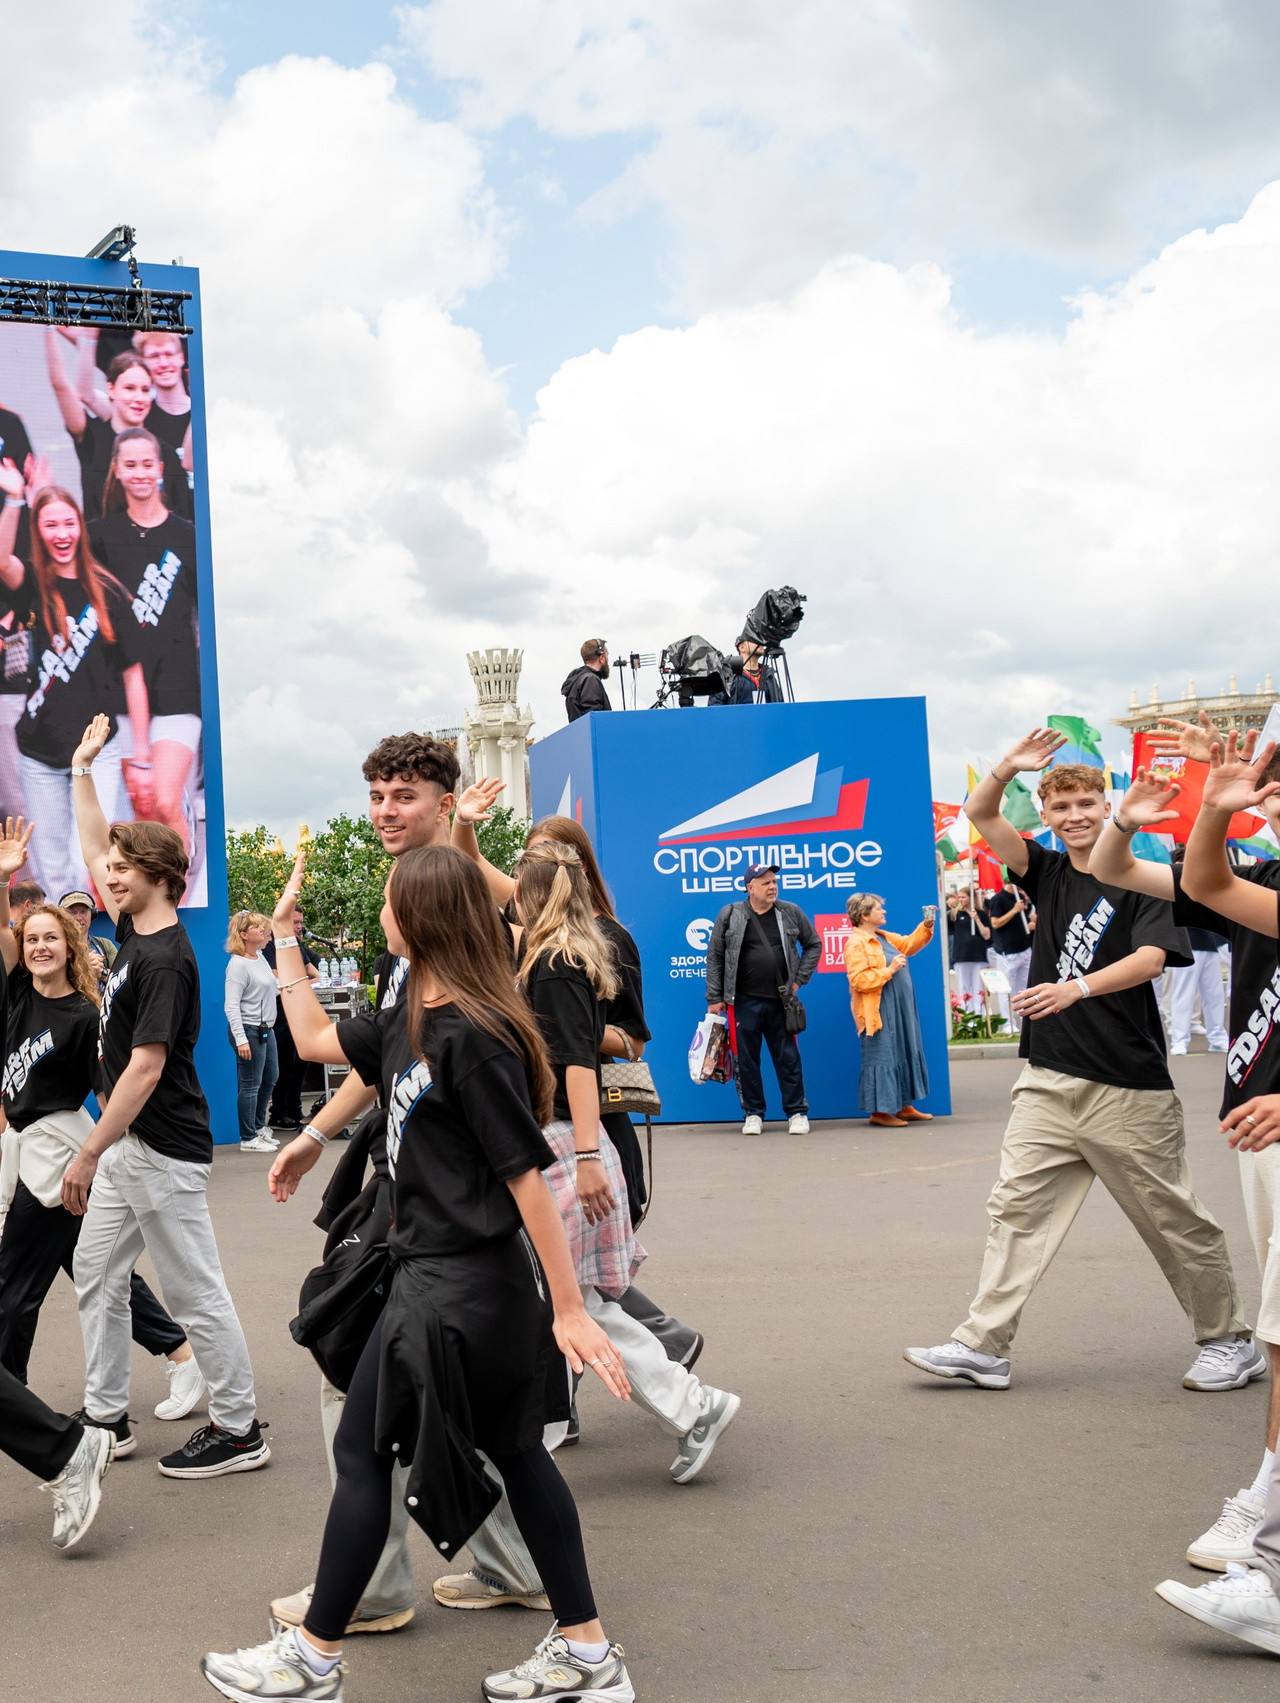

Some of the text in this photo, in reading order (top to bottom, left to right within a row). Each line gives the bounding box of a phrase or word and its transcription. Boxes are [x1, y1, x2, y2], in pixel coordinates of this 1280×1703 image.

[653, 841, 883, 875] СПОРТИВНОЕ
[681, 872, 857, 893] ШЕСВИЕ
[670, 956, 708, 967] ЗДОР
[825, 953, 845, 965] ВД
[1056, 912, 1087, 984] SARR
[670, 968, 707, 979] ОТЕЧЕ
[0, 1036, 31, 1093] ARR
[5, 1030, 55, 1102] TEAM
